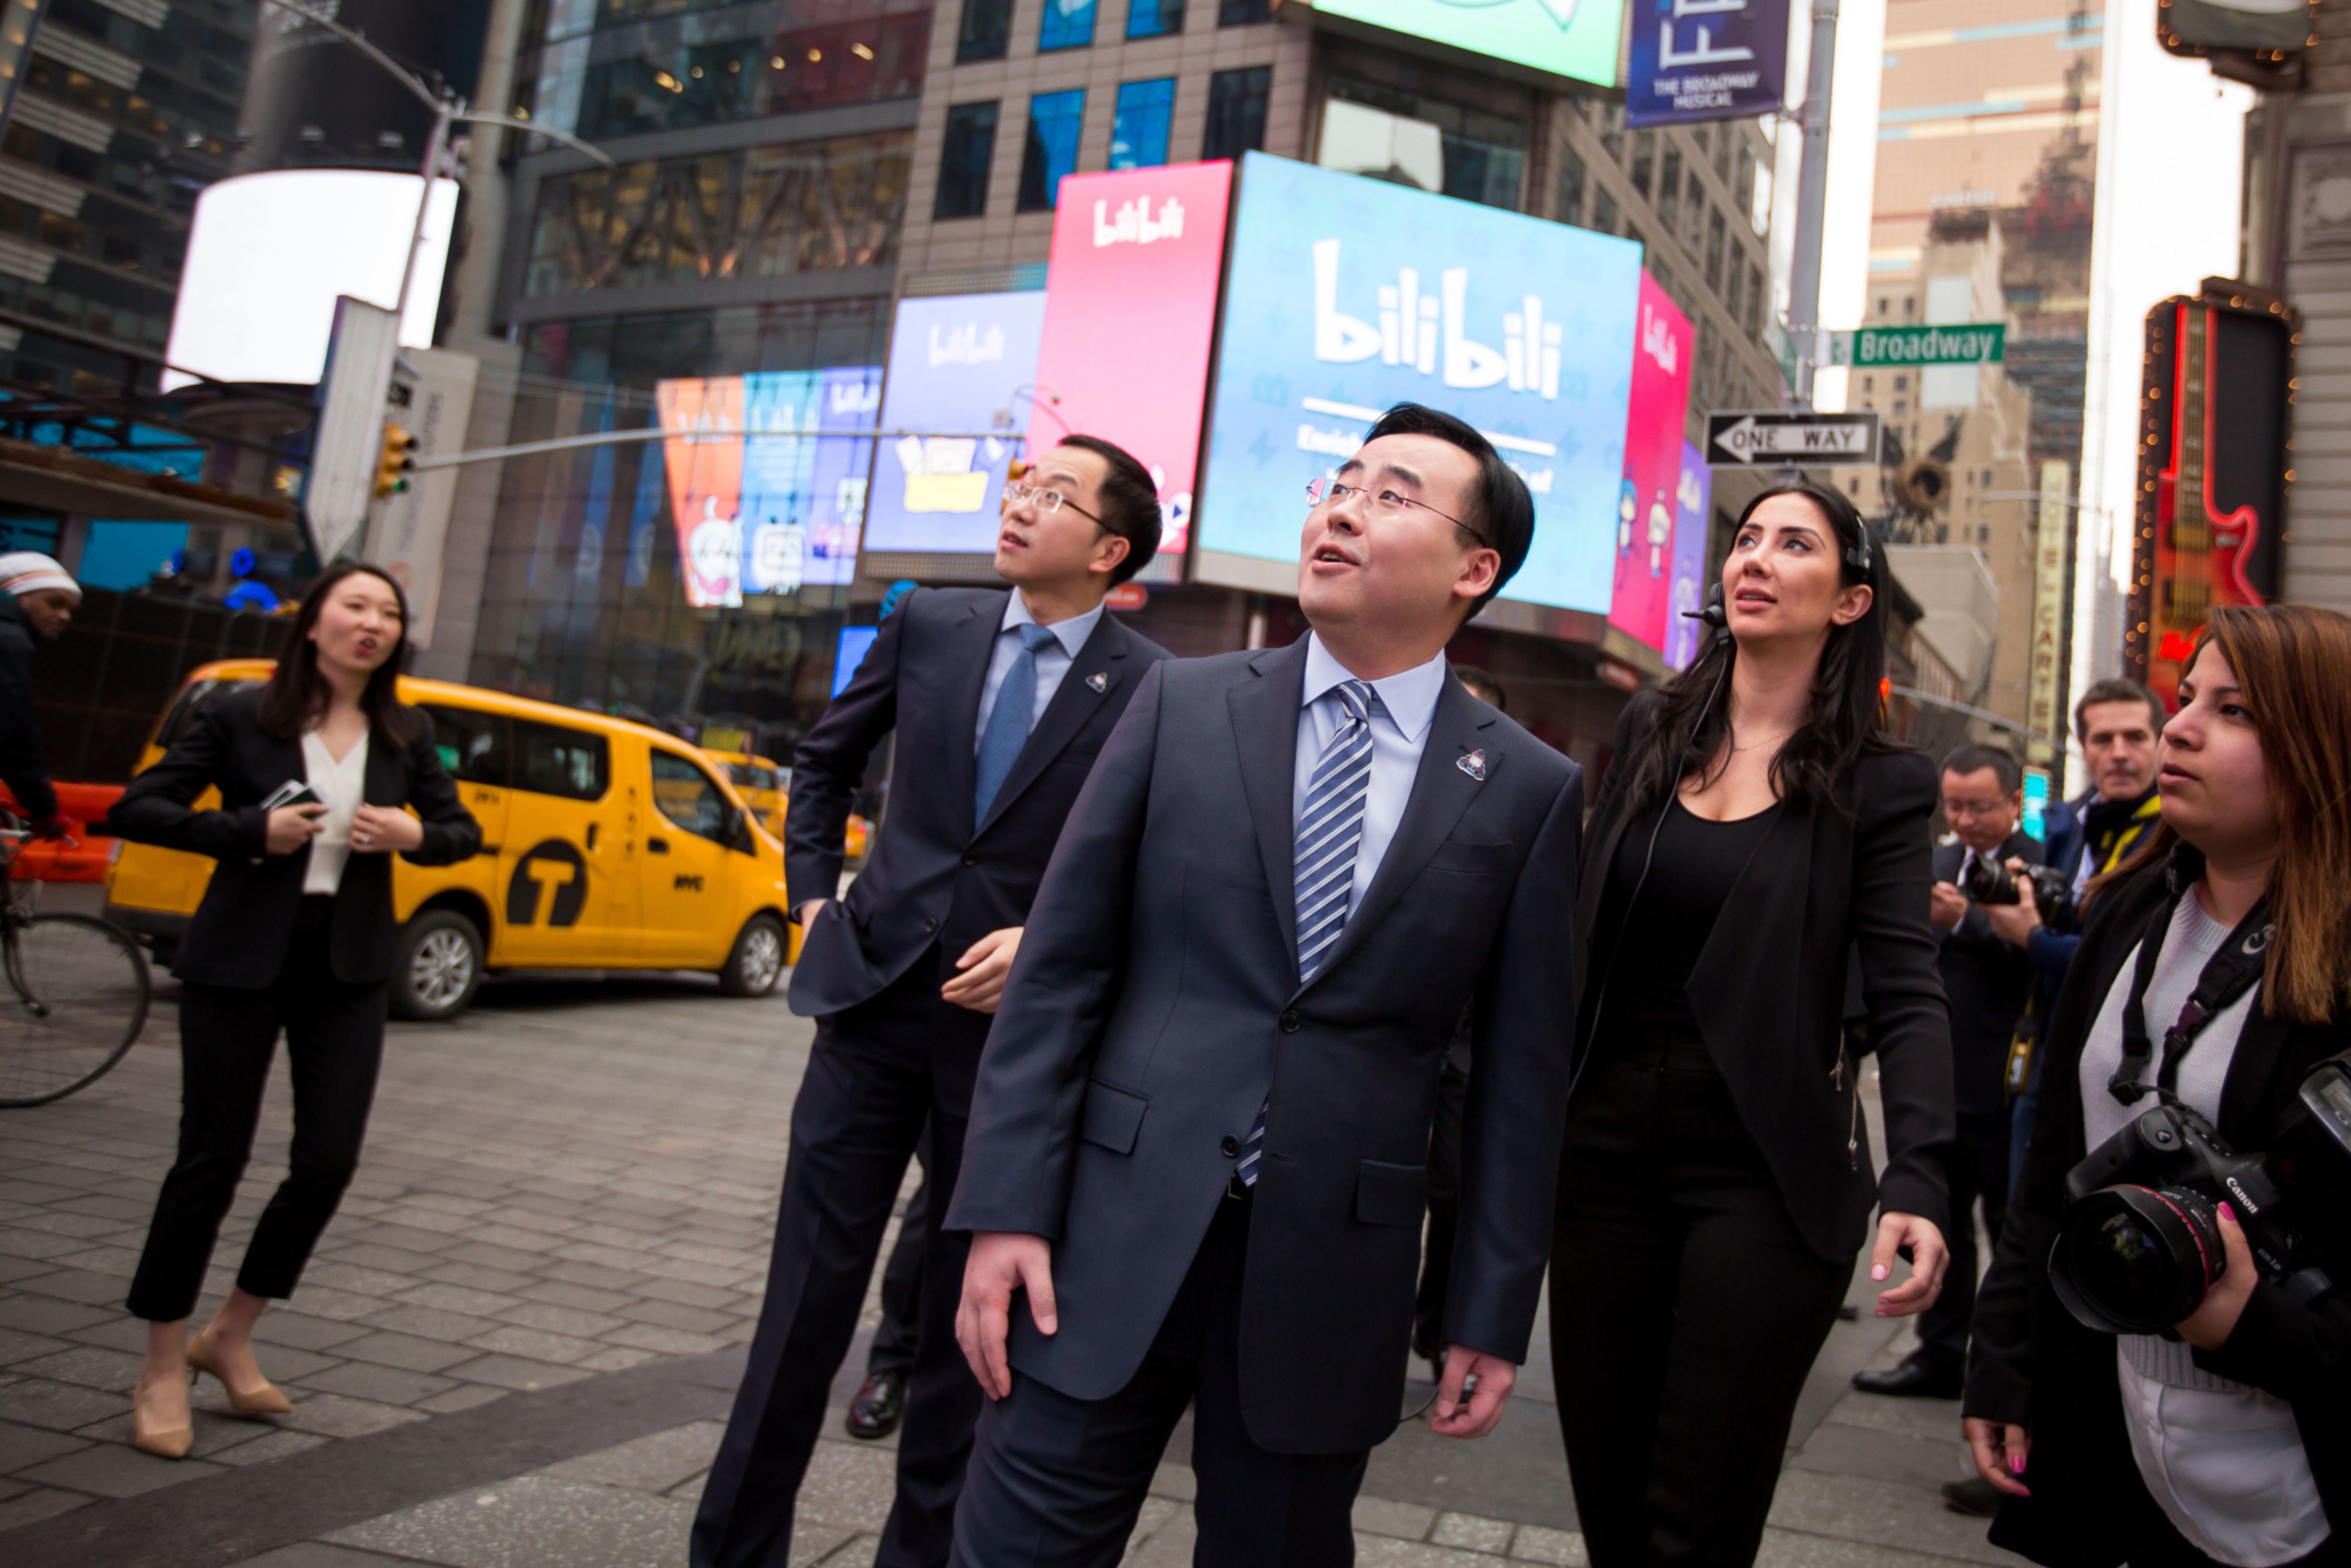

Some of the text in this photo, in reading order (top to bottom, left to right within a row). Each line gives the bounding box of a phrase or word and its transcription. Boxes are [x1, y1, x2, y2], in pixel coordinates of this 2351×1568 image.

[1654, 72, 1760, 96] THE BROADWAY
[1673, 91, 1734, 110] MUSICAL
[1313, 238, 1563, 400] bilibili
[1860, 328, 1996, 363] Broadway
[1732, 426, 1855, 450] ONE WAY
[675, 873, 704, 891] NYC
[2225, 1176, 2259, 1214] Canon
